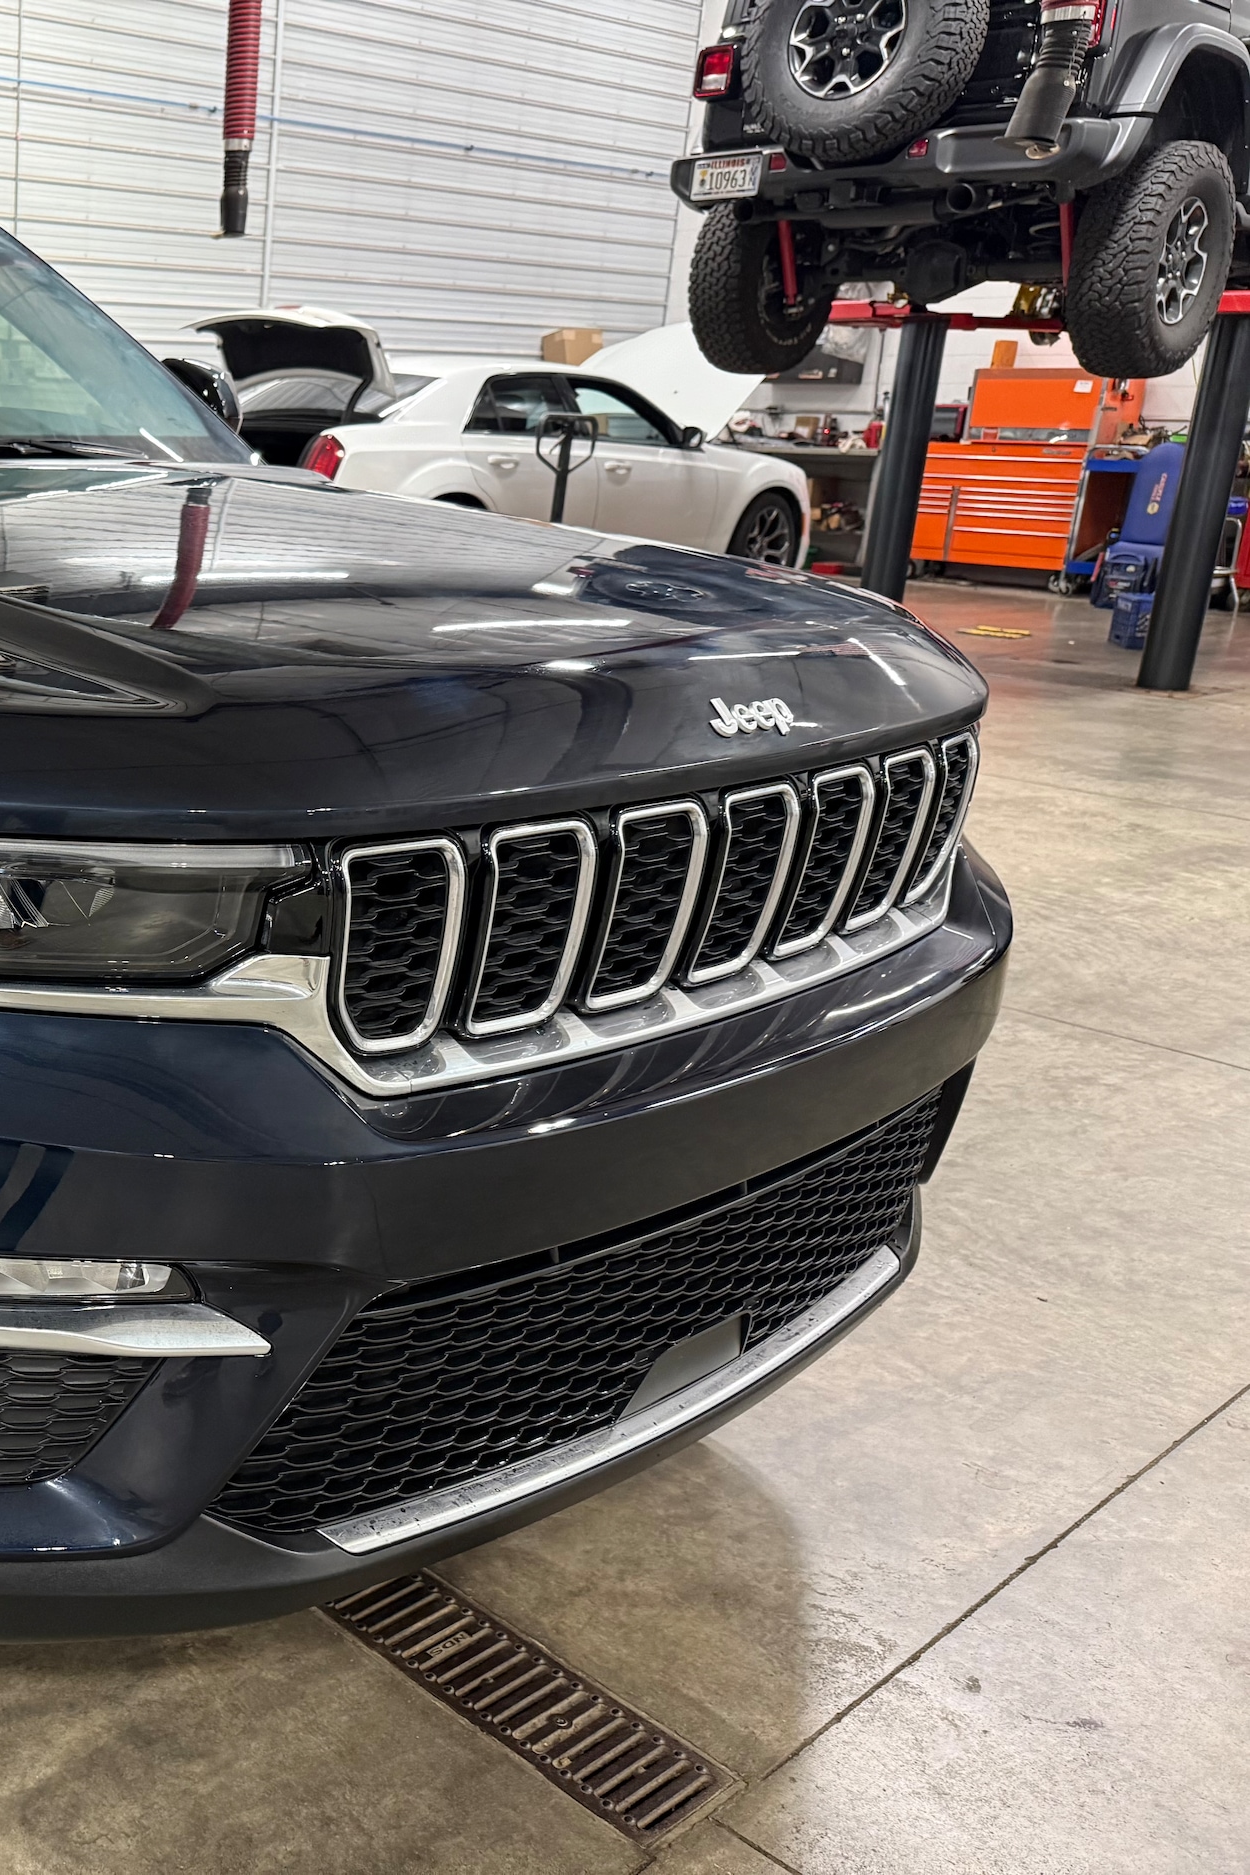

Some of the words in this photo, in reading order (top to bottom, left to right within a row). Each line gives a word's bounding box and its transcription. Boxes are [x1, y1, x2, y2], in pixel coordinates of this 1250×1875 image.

[710, 158, 746, 170] ILLINOIS
[708, 169, 747, 190] 10963
[709, 697, 794, 738] Jeep
[429, 1633, 467, 1656] NDS
